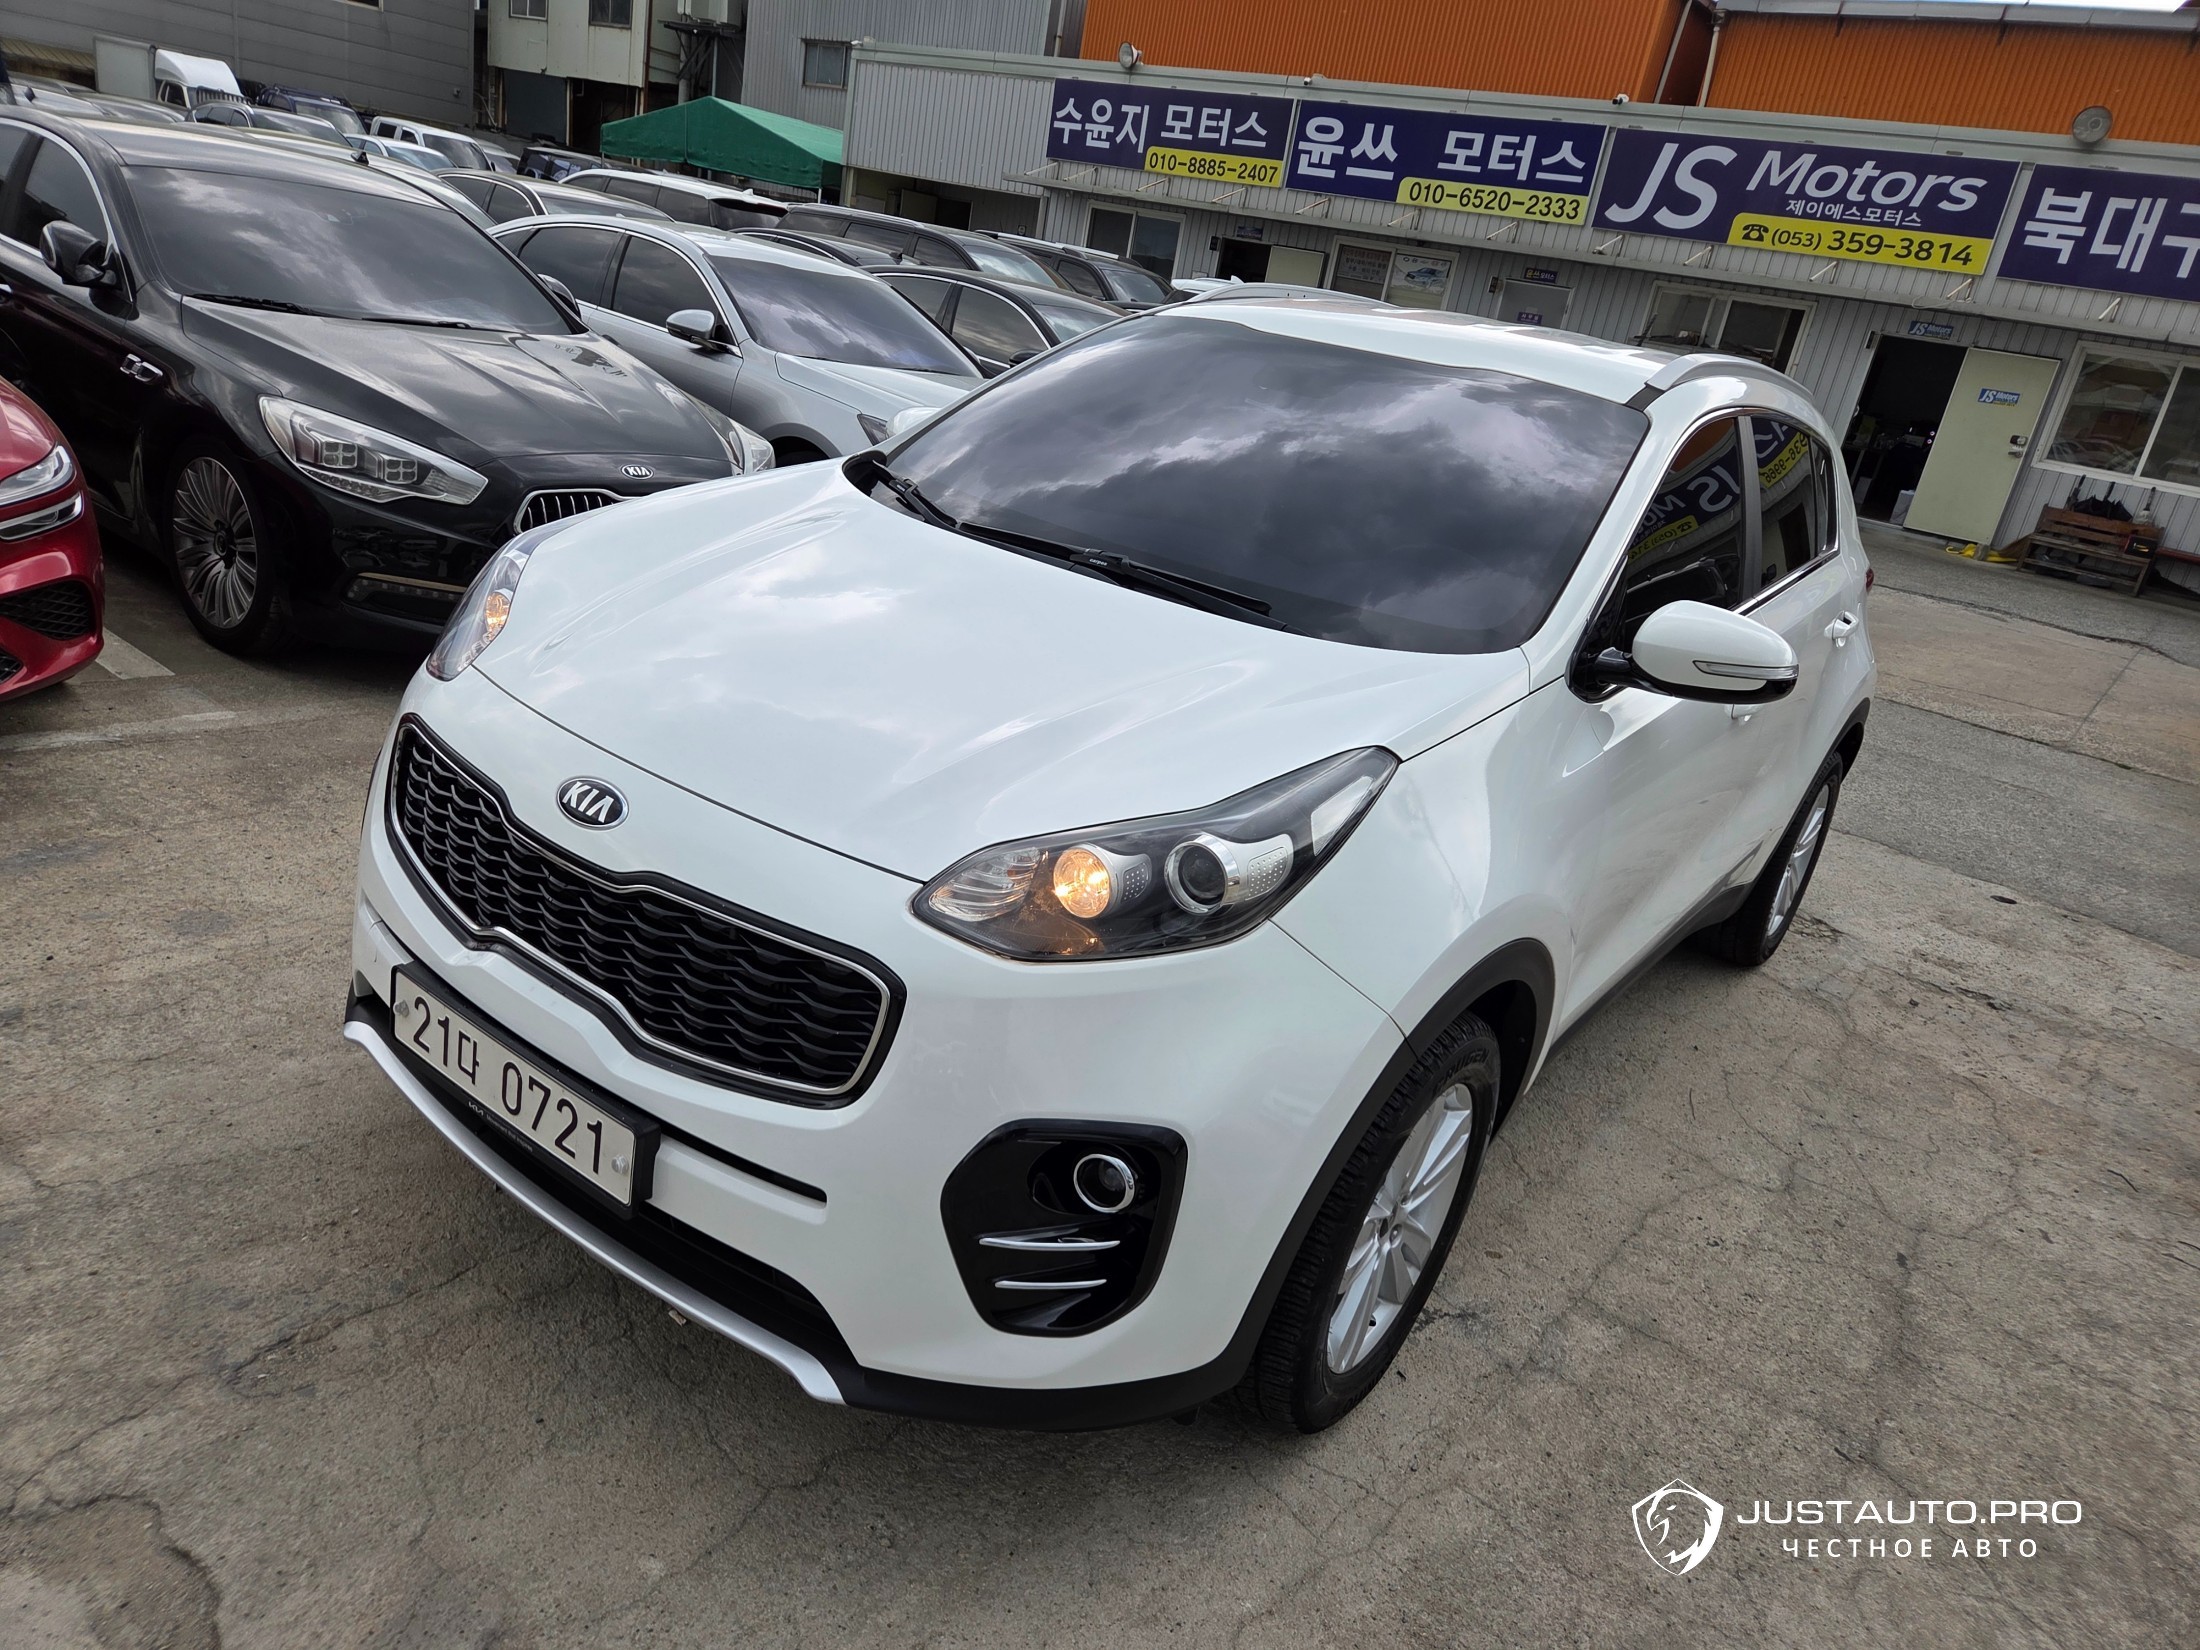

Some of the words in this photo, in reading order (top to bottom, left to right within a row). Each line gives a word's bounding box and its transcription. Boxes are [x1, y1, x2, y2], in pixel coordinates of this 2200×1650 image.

[1053, 97, 1149, 153] 수윤지
[1160, 104, 1268, 149] 모터스
[1148, 152, 1279, 184] 010-8885-2407
[1298, 115, 1399, 182] 윤쓰
[1437, 129, 1585, 184] 모터스
[1408, 181, 1581, 221] 010-6520-2333
[1604, 141, 1738, 230] JS
[1746, 149, 1988, 213] Motors
[1785, 198, 1923, 228] 제이에스모터스
[1770, 230, 1822, 252] (053)
[1826, 229, 1974, 266] 359-3814
[626, 466, 651, 476] KIA
[561, 781, 615, 823] KIA
[413, 996, 480, 1085] 21다
[501, 1061, 603, 1175] 0721
